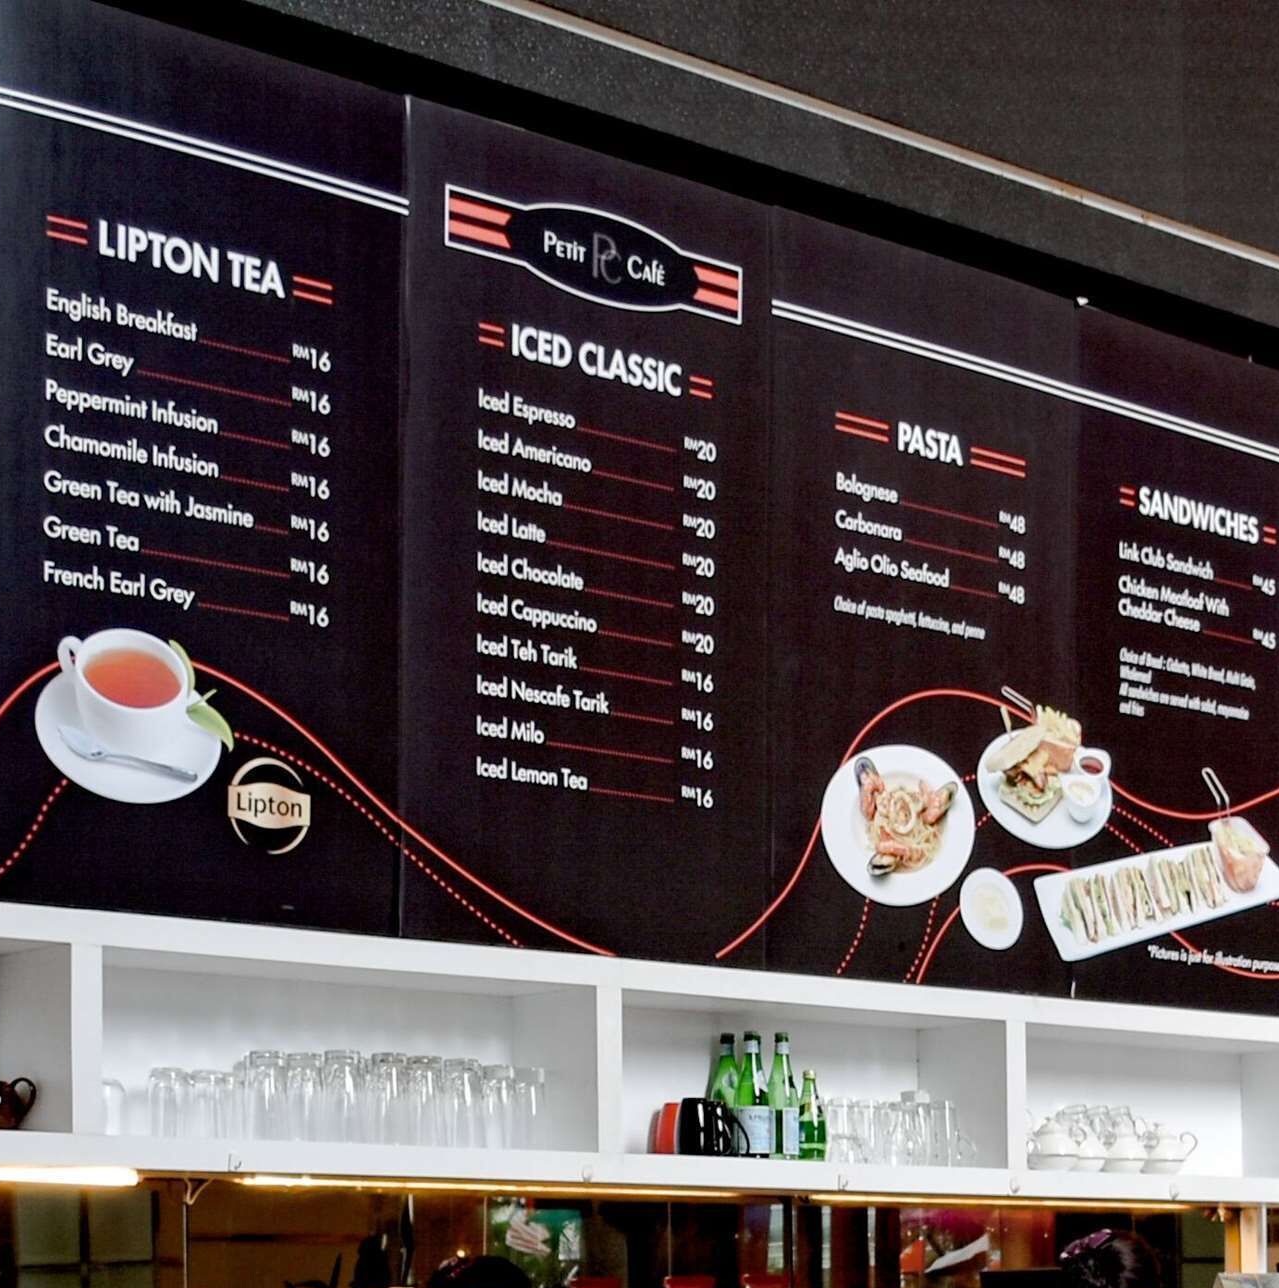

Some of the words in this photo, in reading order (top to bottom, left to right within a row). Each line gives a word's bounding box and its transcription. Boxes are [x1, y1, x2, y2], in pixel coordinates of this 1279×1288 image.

[99, 220, 219, 282] LIPTON
[227, 251, 285, 298] TEA
[47, 288, 111, 322] English
[117, 303, 197, 341] Breakfast
[47, 333, 82, 361] Earl
[87, 343, 134, 376] Grey
[293, 344, 331, 372] RM16
[512, 324, 572, 367] ICED
[579, 342, 681, 396] CLASSIC
[46, 379, 148, 419] Peppermint
[152, 400, 218, 434] Infusion
[292, 387, 330, 414] RM16
[479, 388, 509, 413] Iced
[513, 396, 575, 428] Espresso
[45, 424, 148, 463] Chamomile
[153, 445, 218, 477] Infusion
[292, 429, 330, 457] RM16
[478, 429, 509, 454] Iced
[512, 438, 591, 472] Americano
[684, 437, 716, 462] RM20
[898, 422, 963, 466] PASTA
[44, 470, 101, 500] Green
[107, 481, 139, 506] Tea
[144, 490, 180, 514] with
[185, 496, 253, 528] Jasmine
[291, 472, 329, 499] RM16
[478, 470, 508, 494] Iced
[512, 478, 562, 506] Mocha
[684, 475, 715, 500] RM20
[836, 472, 898, 503] Bolognese
[291, 515, 329, 542] RM16
[478, 511, 508, 535] Iced
[512, 518, 546, 543] Latte
[683, 514, 715, 539] RM20
[835, 510, 902, 540] Carbonara
[999, 511, 1025, 534] RM48
[1139, 486, 1259, 544] SANDWICHES
[43, 516, 101, 545] Green
[106, 525, 139, 551] Tea
[291, 558, 329, 584] RM16
[478, 552, 508, 575] Iced
[511, 558, 583, 590] Chocolate
[683, 553, 714, 577] RM20
[835, 547, 869, 572] Aglio
[871, 555, 898, 576] Olio
[901, 560, 949, 587] Seafood
[999, 546, 1025, 569] RM48
[1119, 542, 1139, 561] Link
[1141, 547, 1165, 568] Club
[1166, 553, 1213, 580] Sandwich
[44, 561, 104, 590] French
[110, 571, 145, 597] Earl
[150, 578, 195, 610] Grey
[999, 582, 1024, 604] RM48
[1119, 575, 1159, 600] Chicken
[1160, 586, 1204, 610] Meatloaf
[1205, 596, 1229, 616] With
[290, 601, 329, 627] RM16
[477, 593, 508, 616] Iced
[511, 599, 597, 632] Cappuccino
[682, 592, 714, 616] RM20
[1119, 598, 1163, 623] Cheddar
[1164, 608, 1200, 632] Cheese
[477, 634, 507, 657] Iced
[511, 639, 537, 662] Teh
[541, 644, 577, 669] Tarik
[682, 630, 714, 654] RM20
[477, 675, 507, 697] Iced
[512, 680, 570, 707] Nescafe
[573, 690, 609, 714] Tarik
[682, 669, 713, 692] RM16
[477, 715, 507, 738] Iced
[511, 721, 544, 743] Milo
[682, 708, 713, 731] RM16
[477, 756, 507, 779] Iced
[512, 761, 557, 786] Lemon
[561, 768, 587, 790] Tea
[682, 747, 713, 769] RM16
[237, 792, 301, 817] Lipton
[682, 786, 713, 808] RM16
[1180, 949, 1188, 961] is
